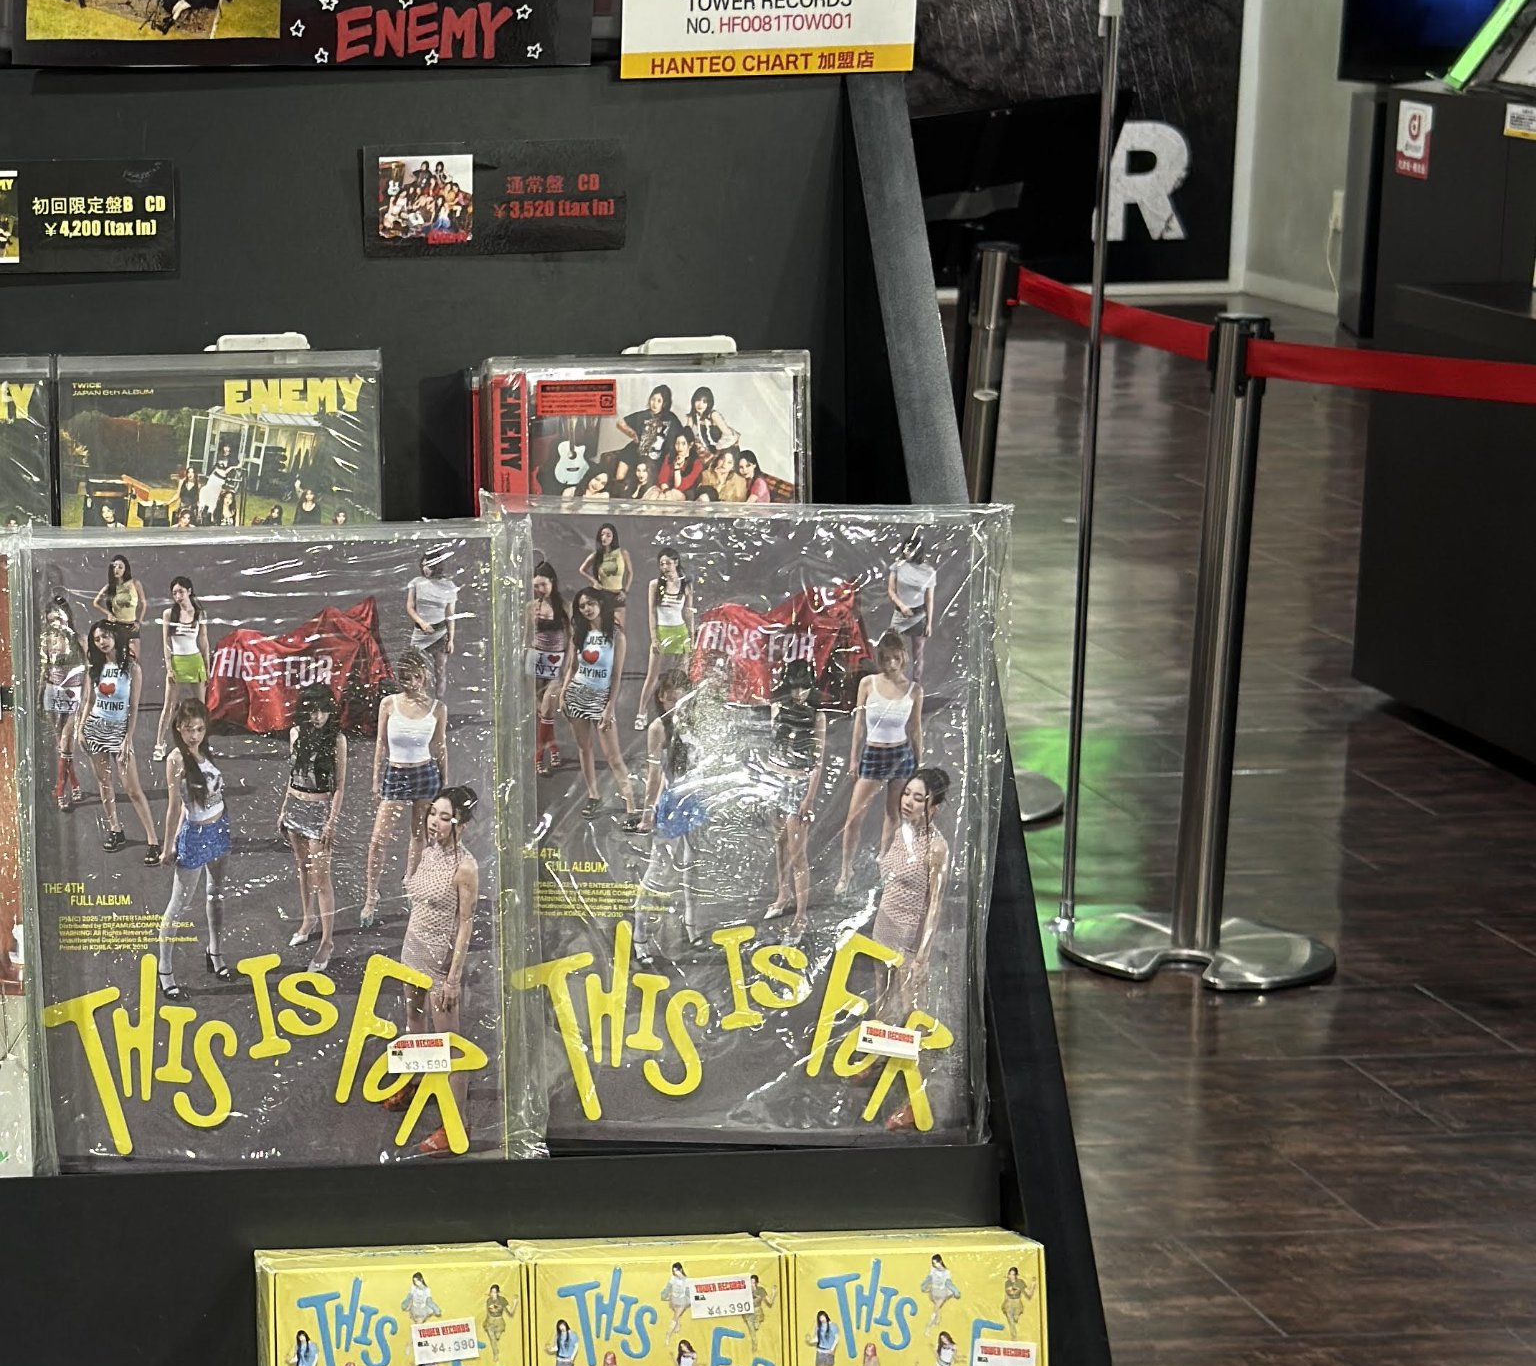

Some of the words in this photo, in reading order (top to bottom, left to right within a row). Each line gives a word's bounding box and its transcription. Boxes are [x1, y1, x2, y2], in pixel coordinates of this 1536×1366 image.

[336, 1, 514, 63] ENEMY
[686, 17, 714, 34] NO.
[651, 55, 736, 75] HANTEO
[742, 53, 812, 72] CHART
[818, 50, 874, 70] 加盟店
[506, 175, 564, 195] 通常盤
[578, 174, 599, 191] CD
[32, 197, 133, 215] 初回限定盤B
[145, 196, 165, 212] CD
[224, 377, 365, 416] ENEMY
[210, 646, 256, 681] THIS
[284, 654, 334, 687] FOR
[44, 883, 63, 893] THE
[64, 883, 84, 893] 4TH
[70, 895, 94, 906] FULL
[512, 920, 710, 1121] THIS
[712, 925, 809, 1031] IS
[807, 932, 953, 1132] FOR
[44, 953, 238, 1155] THIS
[237, 953, 338, 1060] IS
[336, 953, 489, 1154] FOR
[707, 1301, 751, 1316] ¥4,390
[417, 1327, 441, 1337] TOWER
[441, 1323, 470, 1335] RECORDS
[431, 1338, 475, 1353] ¥4,390
